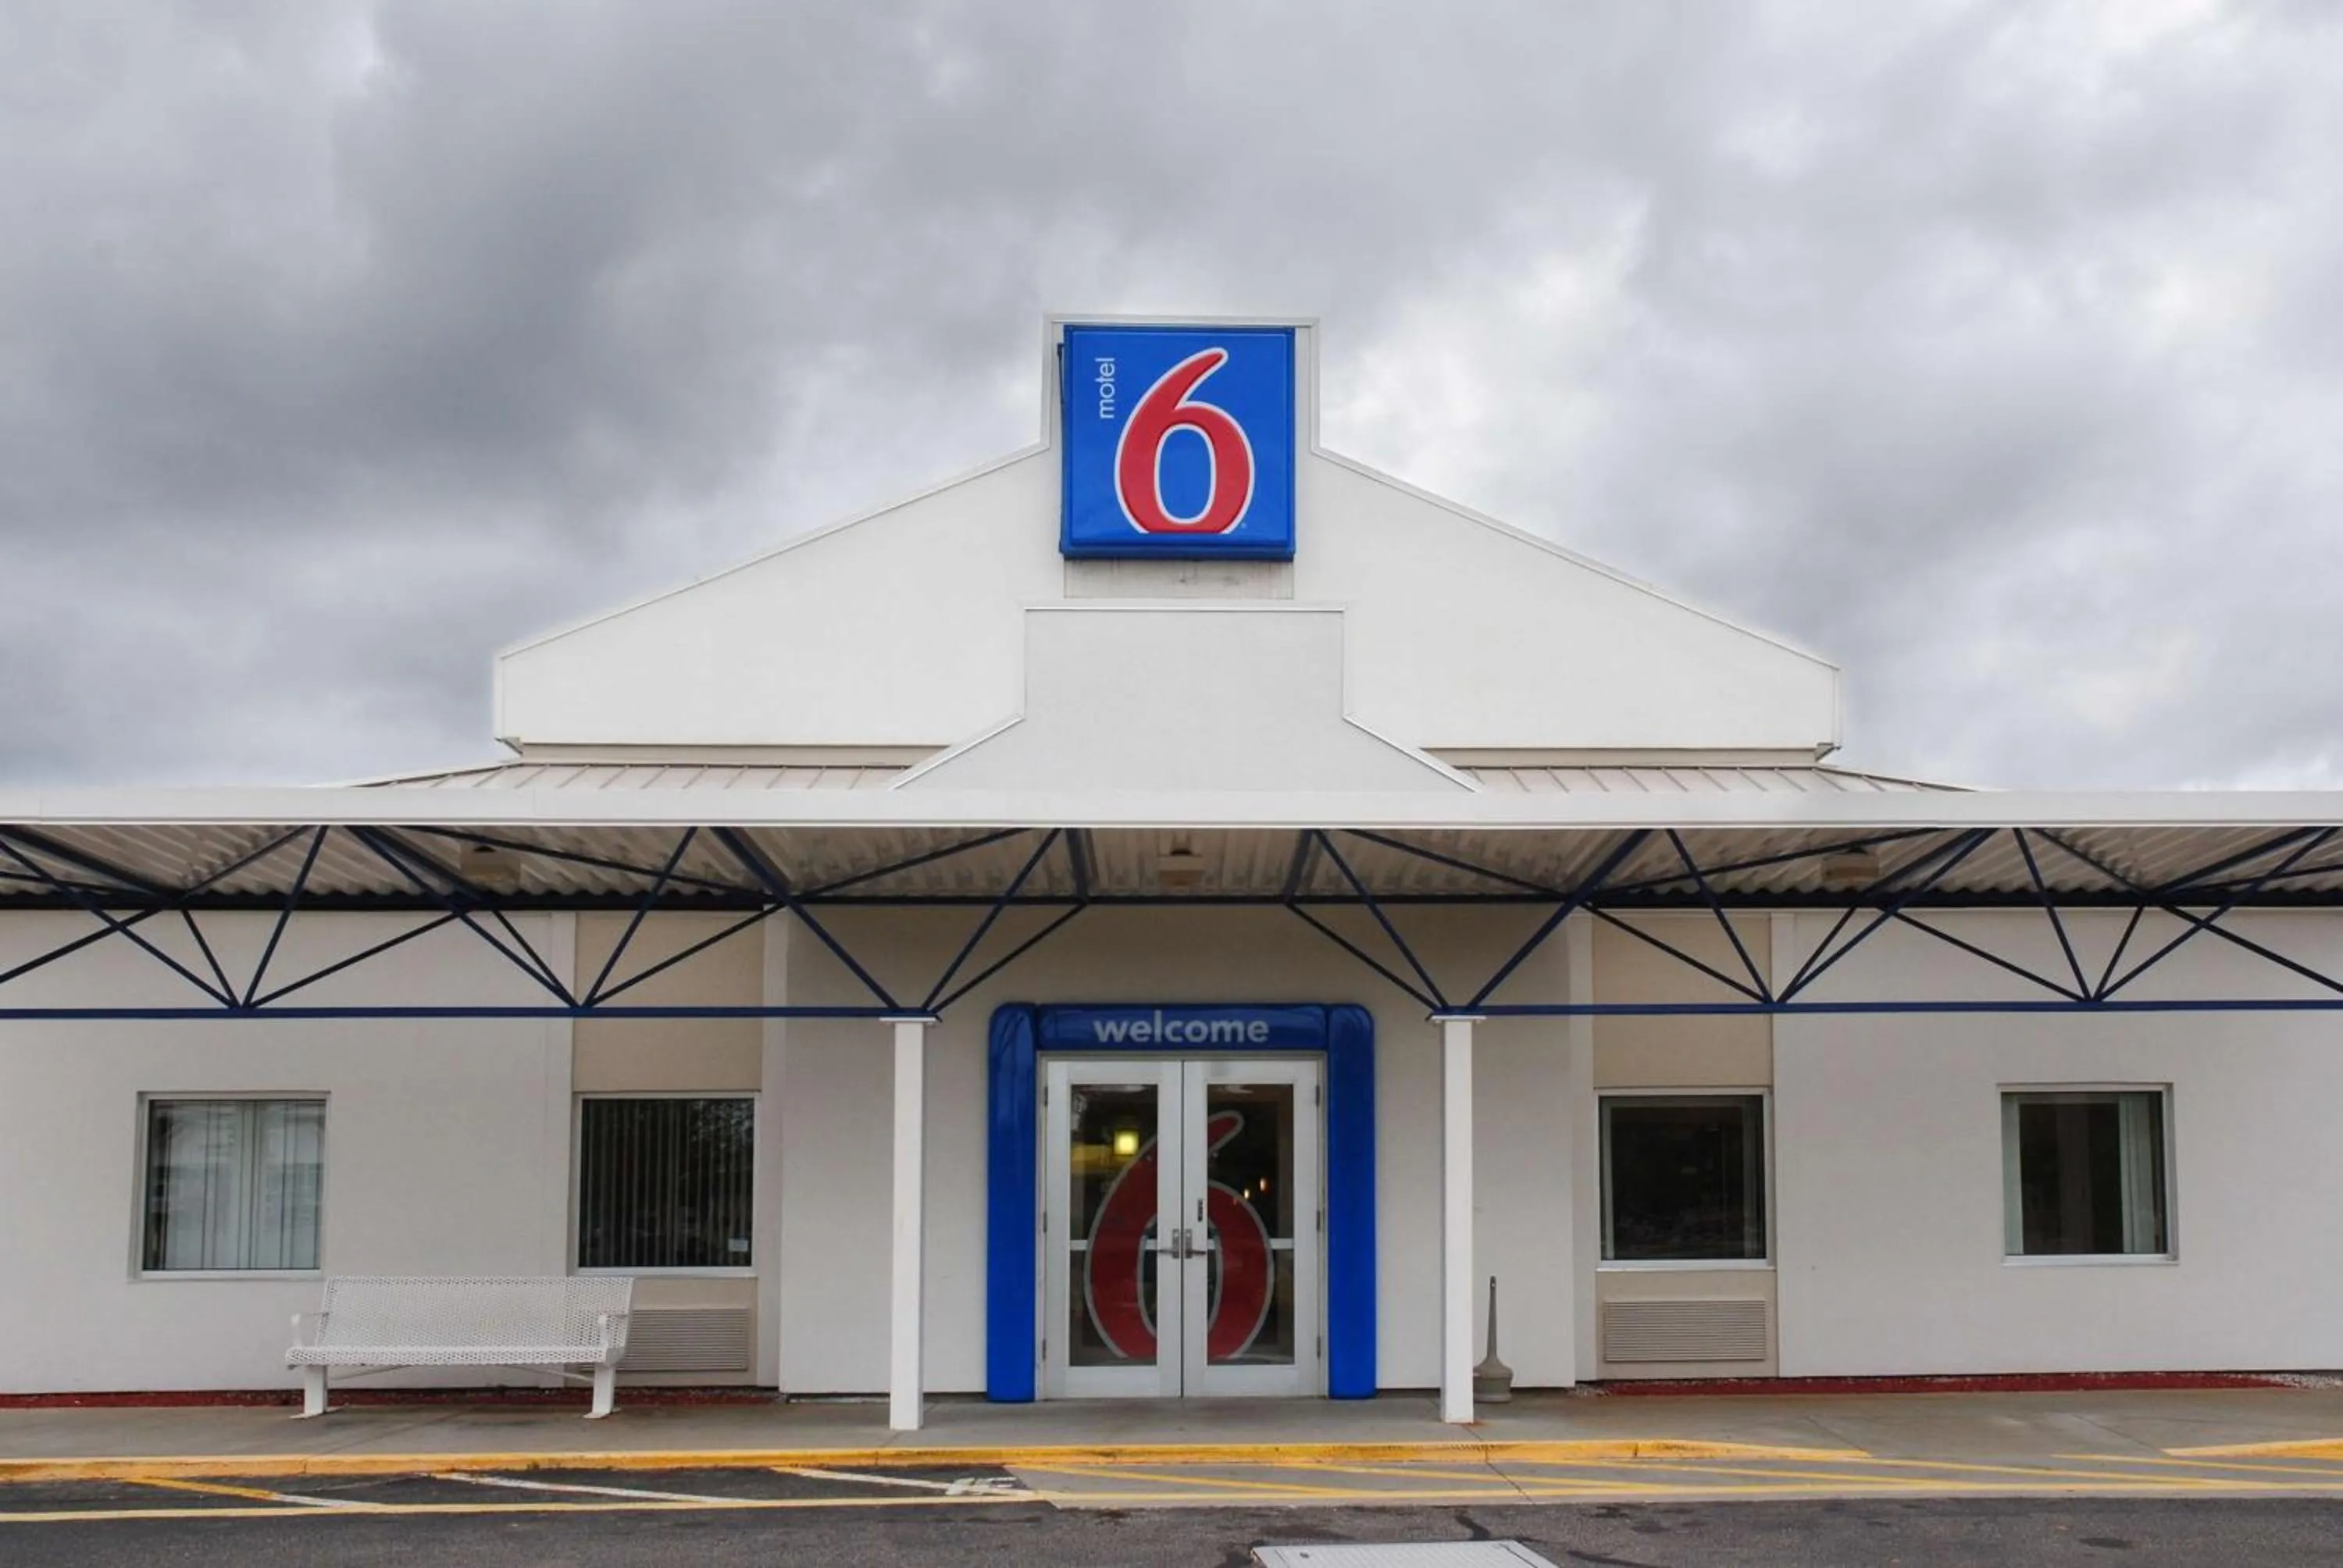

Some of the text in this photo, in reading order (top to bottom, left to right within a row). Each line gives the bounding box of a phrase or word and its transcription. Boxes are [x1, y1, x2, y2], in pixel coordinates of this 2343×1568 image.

[1095, 357, 1115, 419] motel
[1114, 347, 1255, 535] 6
[1093, 1010, 1270, 1044] welcome
[1083, 1110, 1275, 1360] 6
